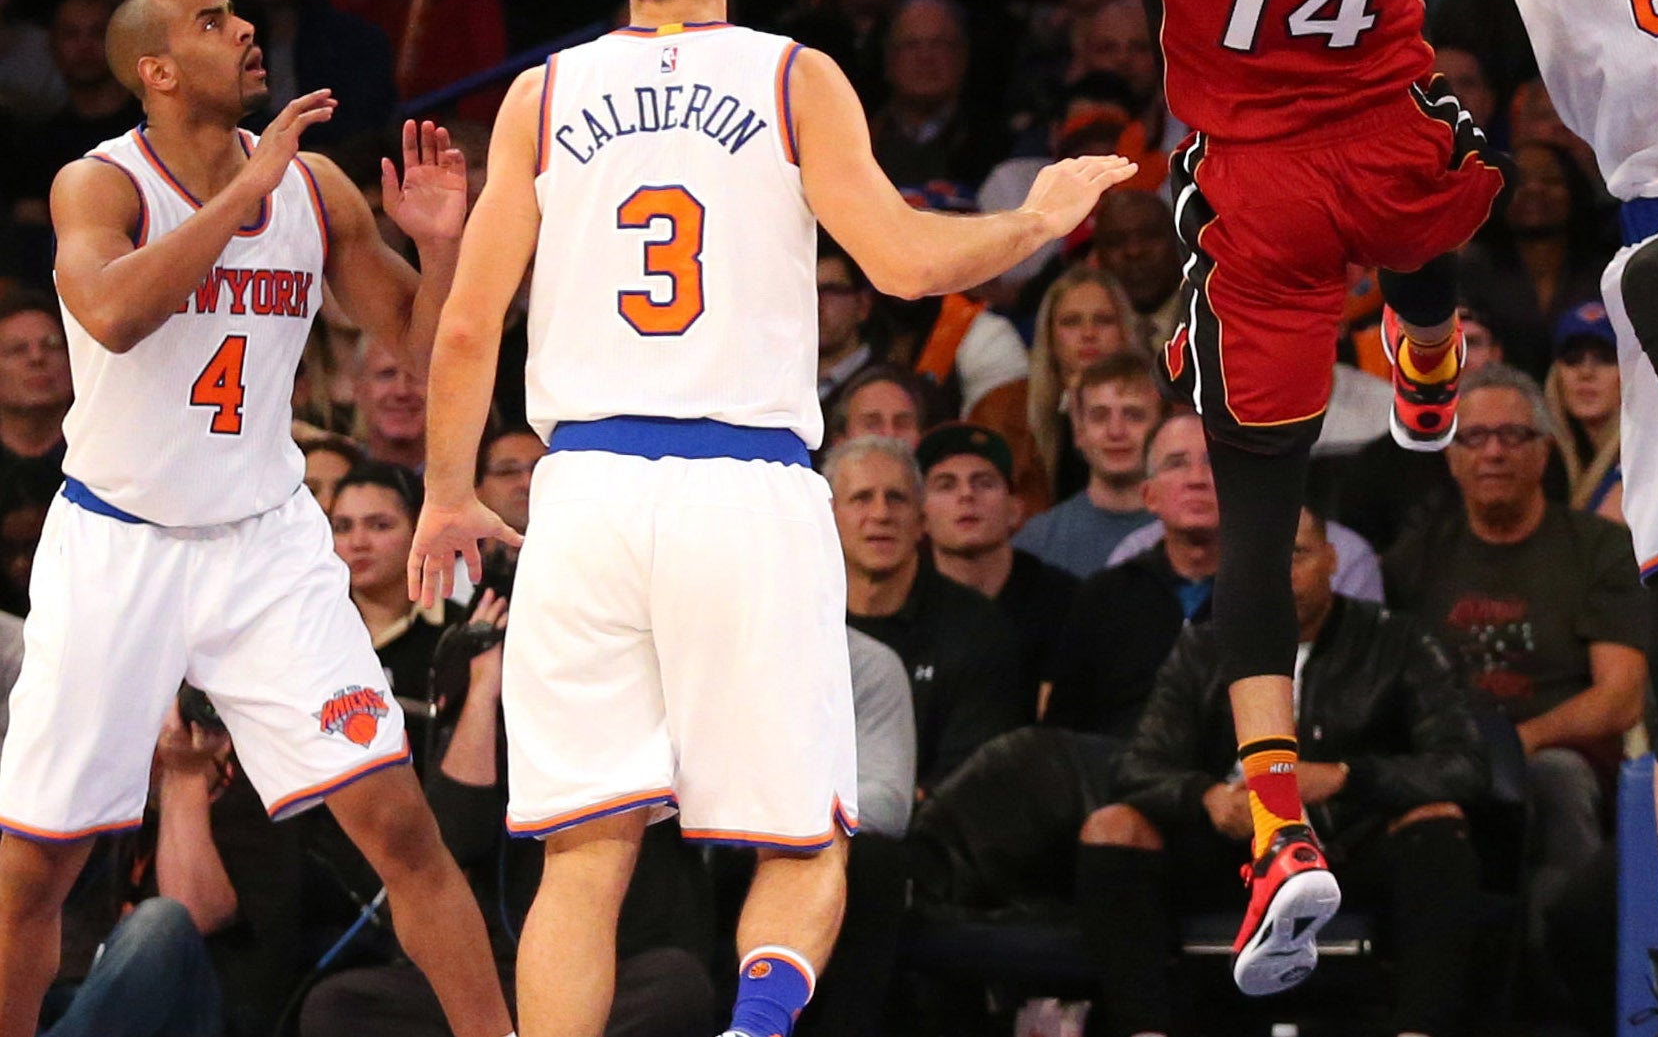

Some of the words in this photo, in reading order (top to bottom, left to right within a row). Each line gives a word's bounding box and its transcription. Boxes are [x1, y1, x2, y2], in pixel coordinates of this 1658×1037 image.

[556, 83, 767, 165] CALDERON
[616, 184, 705, 337] 3
[189, 334, 248, 436] 4
